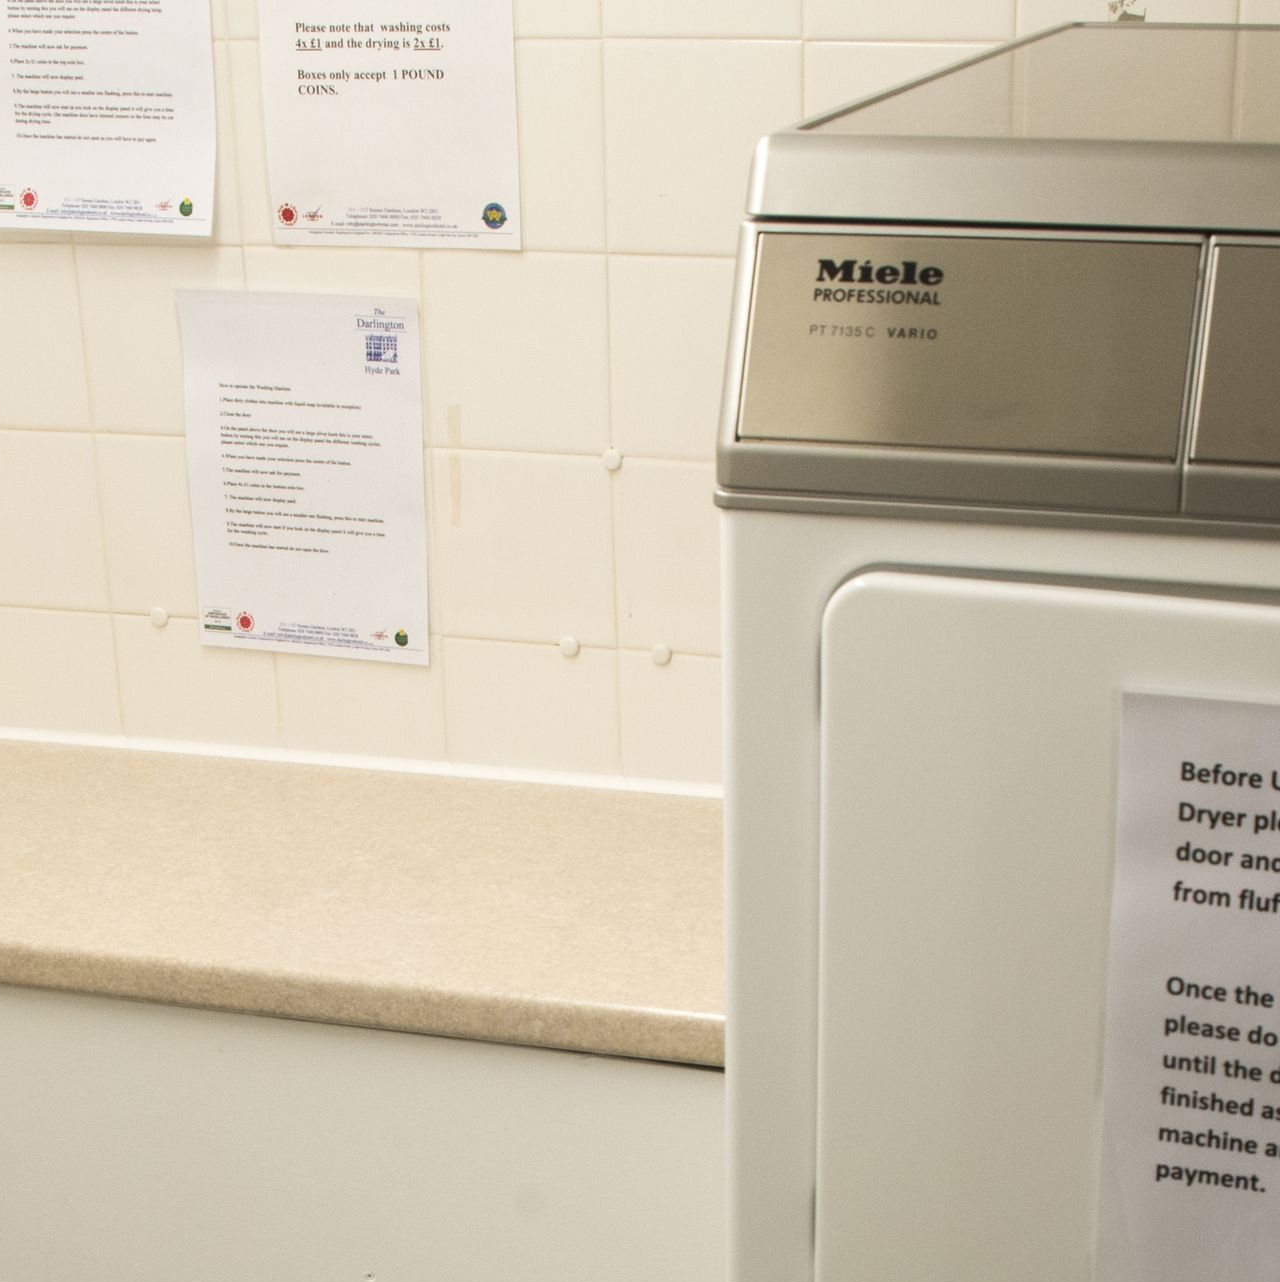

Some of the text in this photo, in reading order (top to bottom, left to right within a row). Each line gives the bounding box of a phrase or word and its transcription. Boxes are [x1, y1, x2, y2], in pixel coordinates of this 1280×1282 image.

[296, 22, 450, 34] Please note that washing costs
[296, 38, 444, 50] 4x £1 and the drying is 2x £1.
[297, 70, 444, 82] Boxes only accept 1 POUND
[298, 86, 338, 95] COINS.
[816, 259, 944, 285] Miele
[813, 288, 941, 305] PROFESSIONAL
[356, 318, 405, 330] Darlington
[374, 308, 386, 316] The
[809, 324, 938, 340] PT 7135 C VARIO
[364, 366, 400, 376] Hyde Park
[1181, 761, 1263, 789] Before
[1178, 802, 1247, 830] Dryer
[1176, 841, 1234, 866] door
[1173, 880, 1231, 908] from
[1166, 976, 1227, 1002] Once
[1234, 985, 1274, 1008] the
[1164, 1015, 1241, 1042] please
[1247, 1025, 1278, 1047] do
[1163, 1055, 1216, 1075] until
[1223, 1059, 1263, 1082] the
[1160, 1086, 1254, 1117] finished
[1158, 1127, 1258, 1155] machine
[1155, 1164, 1266, 1193] payment.
